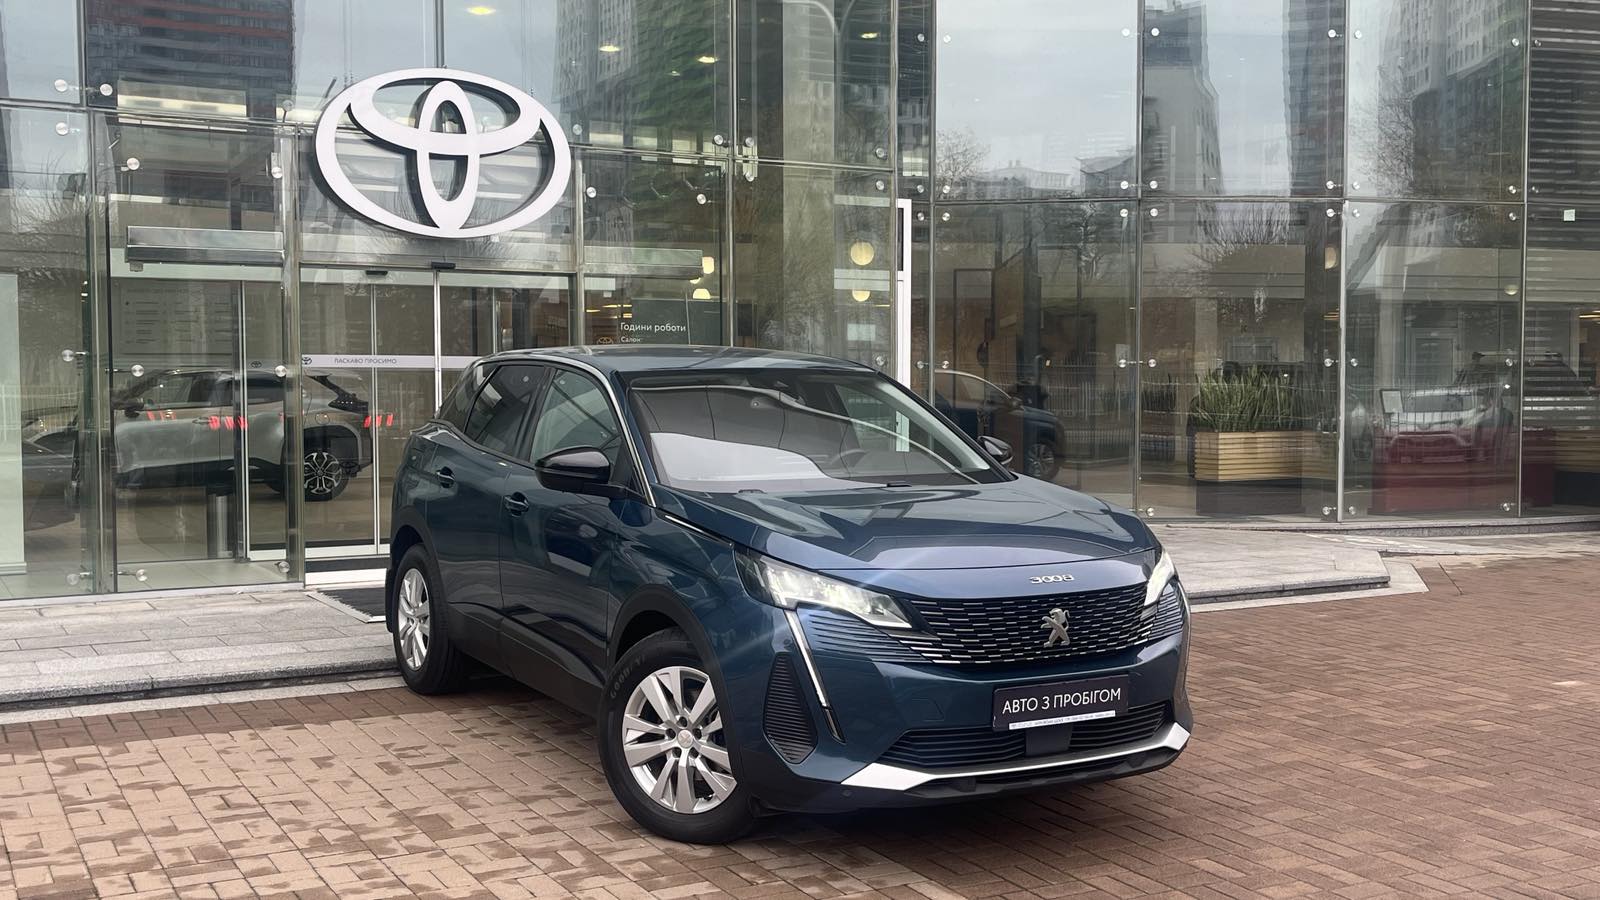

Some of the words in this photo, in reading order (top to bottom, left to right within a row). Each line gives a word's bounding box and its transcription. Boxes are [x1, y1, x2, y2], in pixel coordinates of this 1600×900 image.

[620, 322, 652, 332] Години
[654, 323, 686, 333] роботи
[1030, 574, 1074, 584] 3008
[1002, 698, 1038, 714] АВТО
[1053, 688, 1121, 708] ПРОБІГОМ
